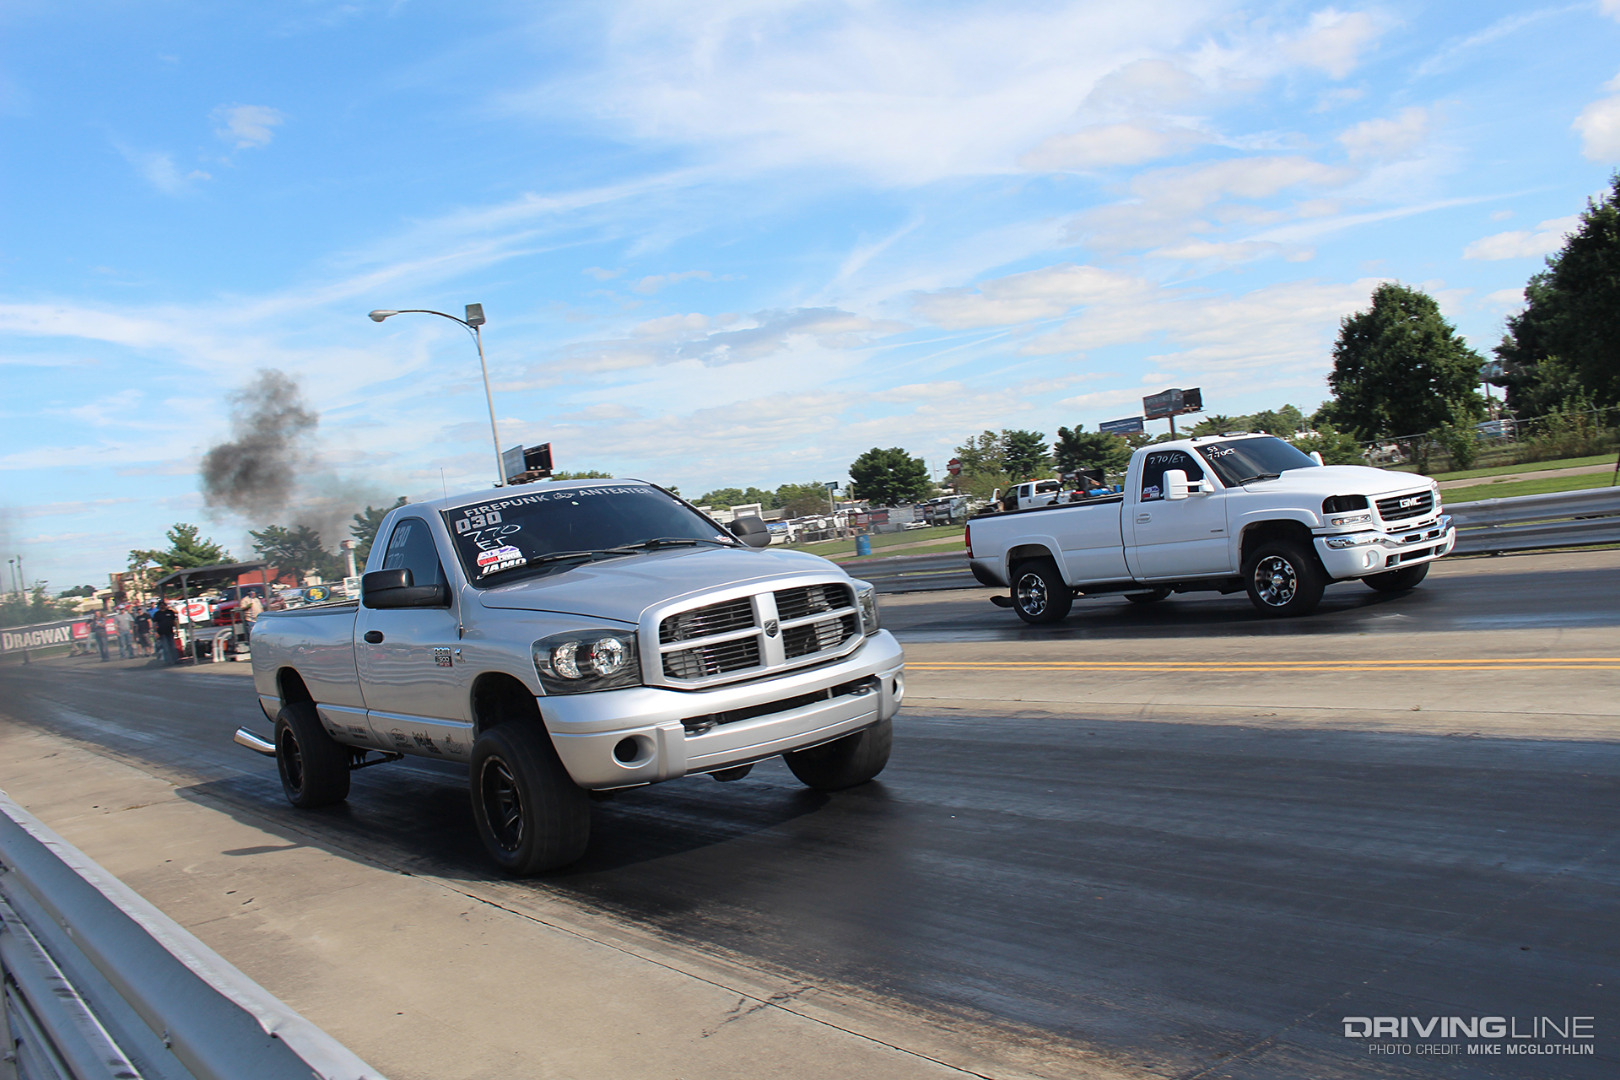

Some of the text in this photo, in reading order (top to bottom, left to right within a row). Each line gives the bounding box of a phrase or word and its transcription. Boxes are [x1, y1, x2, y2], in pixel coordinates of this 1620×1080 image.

[463, 487, 654, 518] FIREPUNK ANTEATER
[1399, 496, 1423, 509] GMC
[462, 524, 521, 543] 7.70
[2, 626, 71, 651] DRAGWAY
